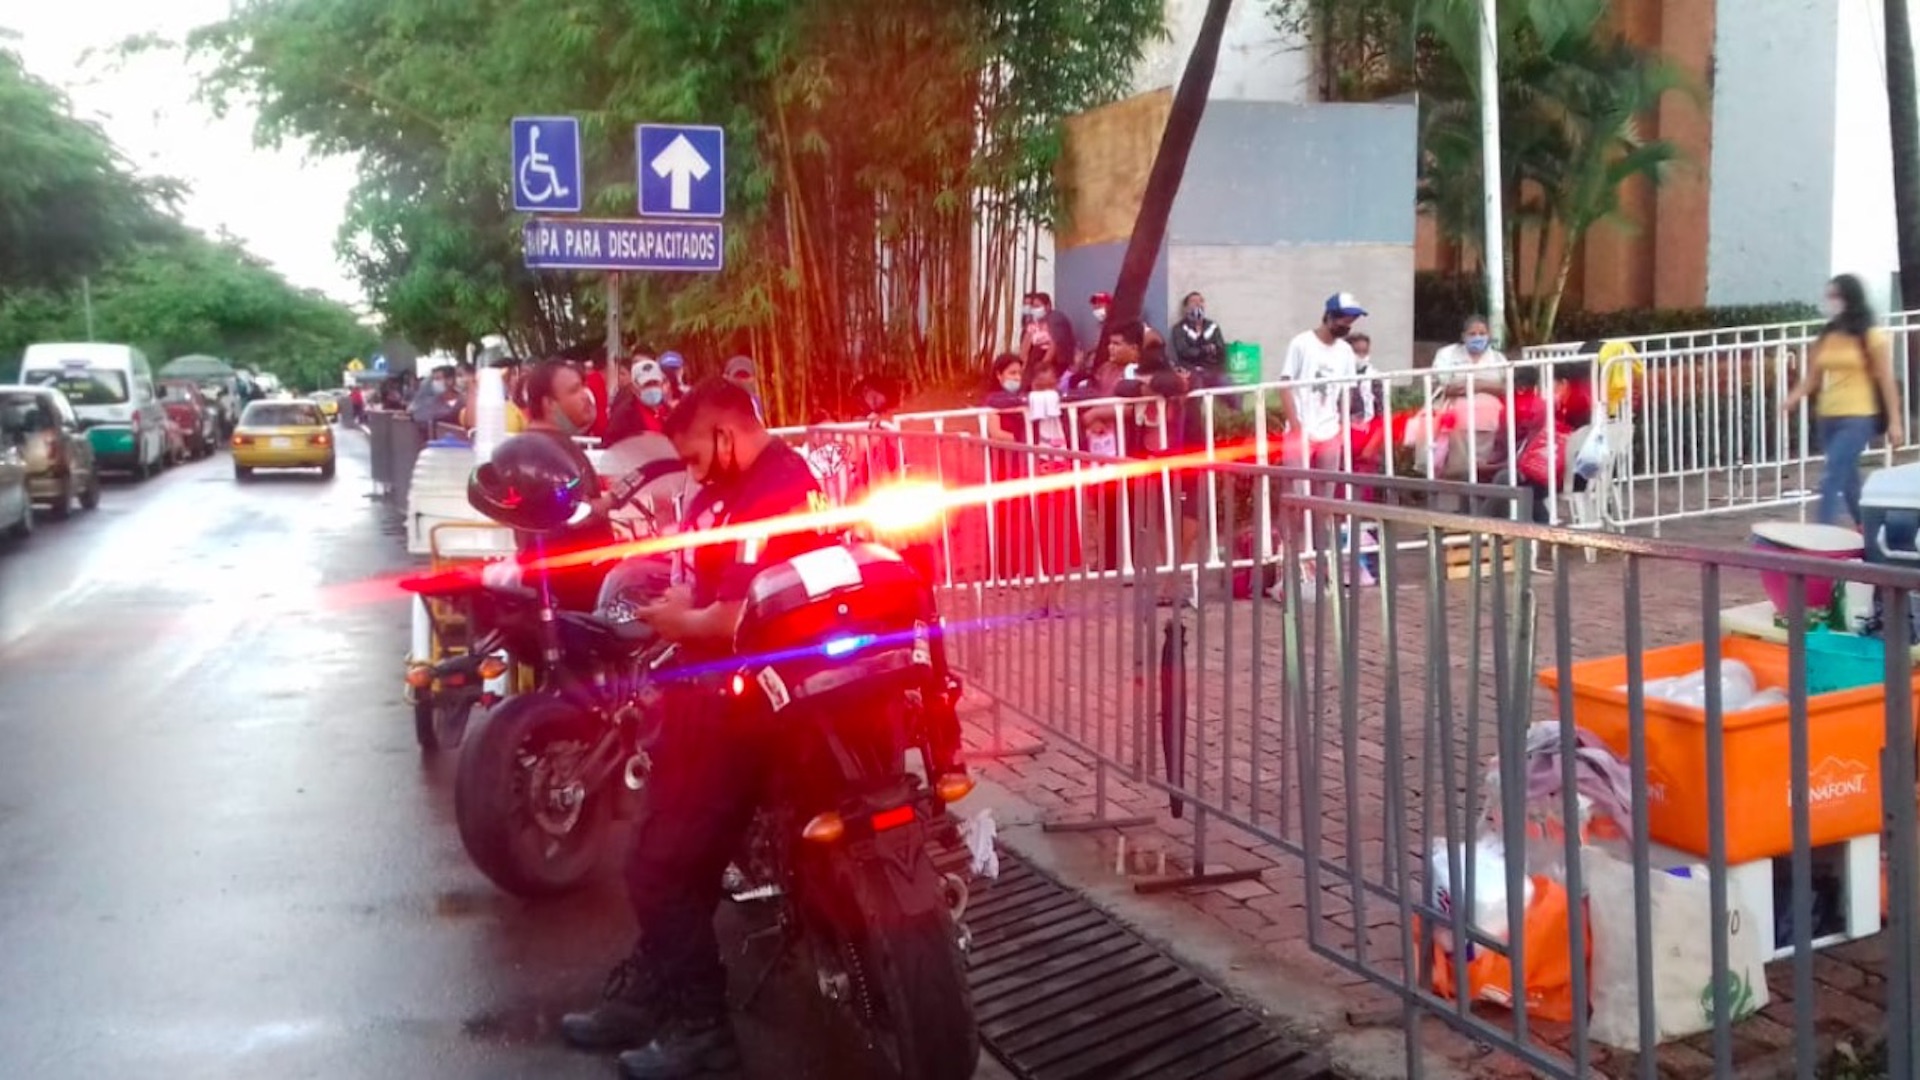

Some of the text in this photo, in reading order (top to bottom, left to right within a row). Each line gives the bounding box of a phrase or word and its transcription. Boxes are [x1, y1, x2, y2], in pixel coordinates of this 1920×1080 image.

[565, 228, 602, 258] PARA
[608, 229, 716, 260] DISCAPACITADOS
[1787, 771, 1866, 807] NAFONT
